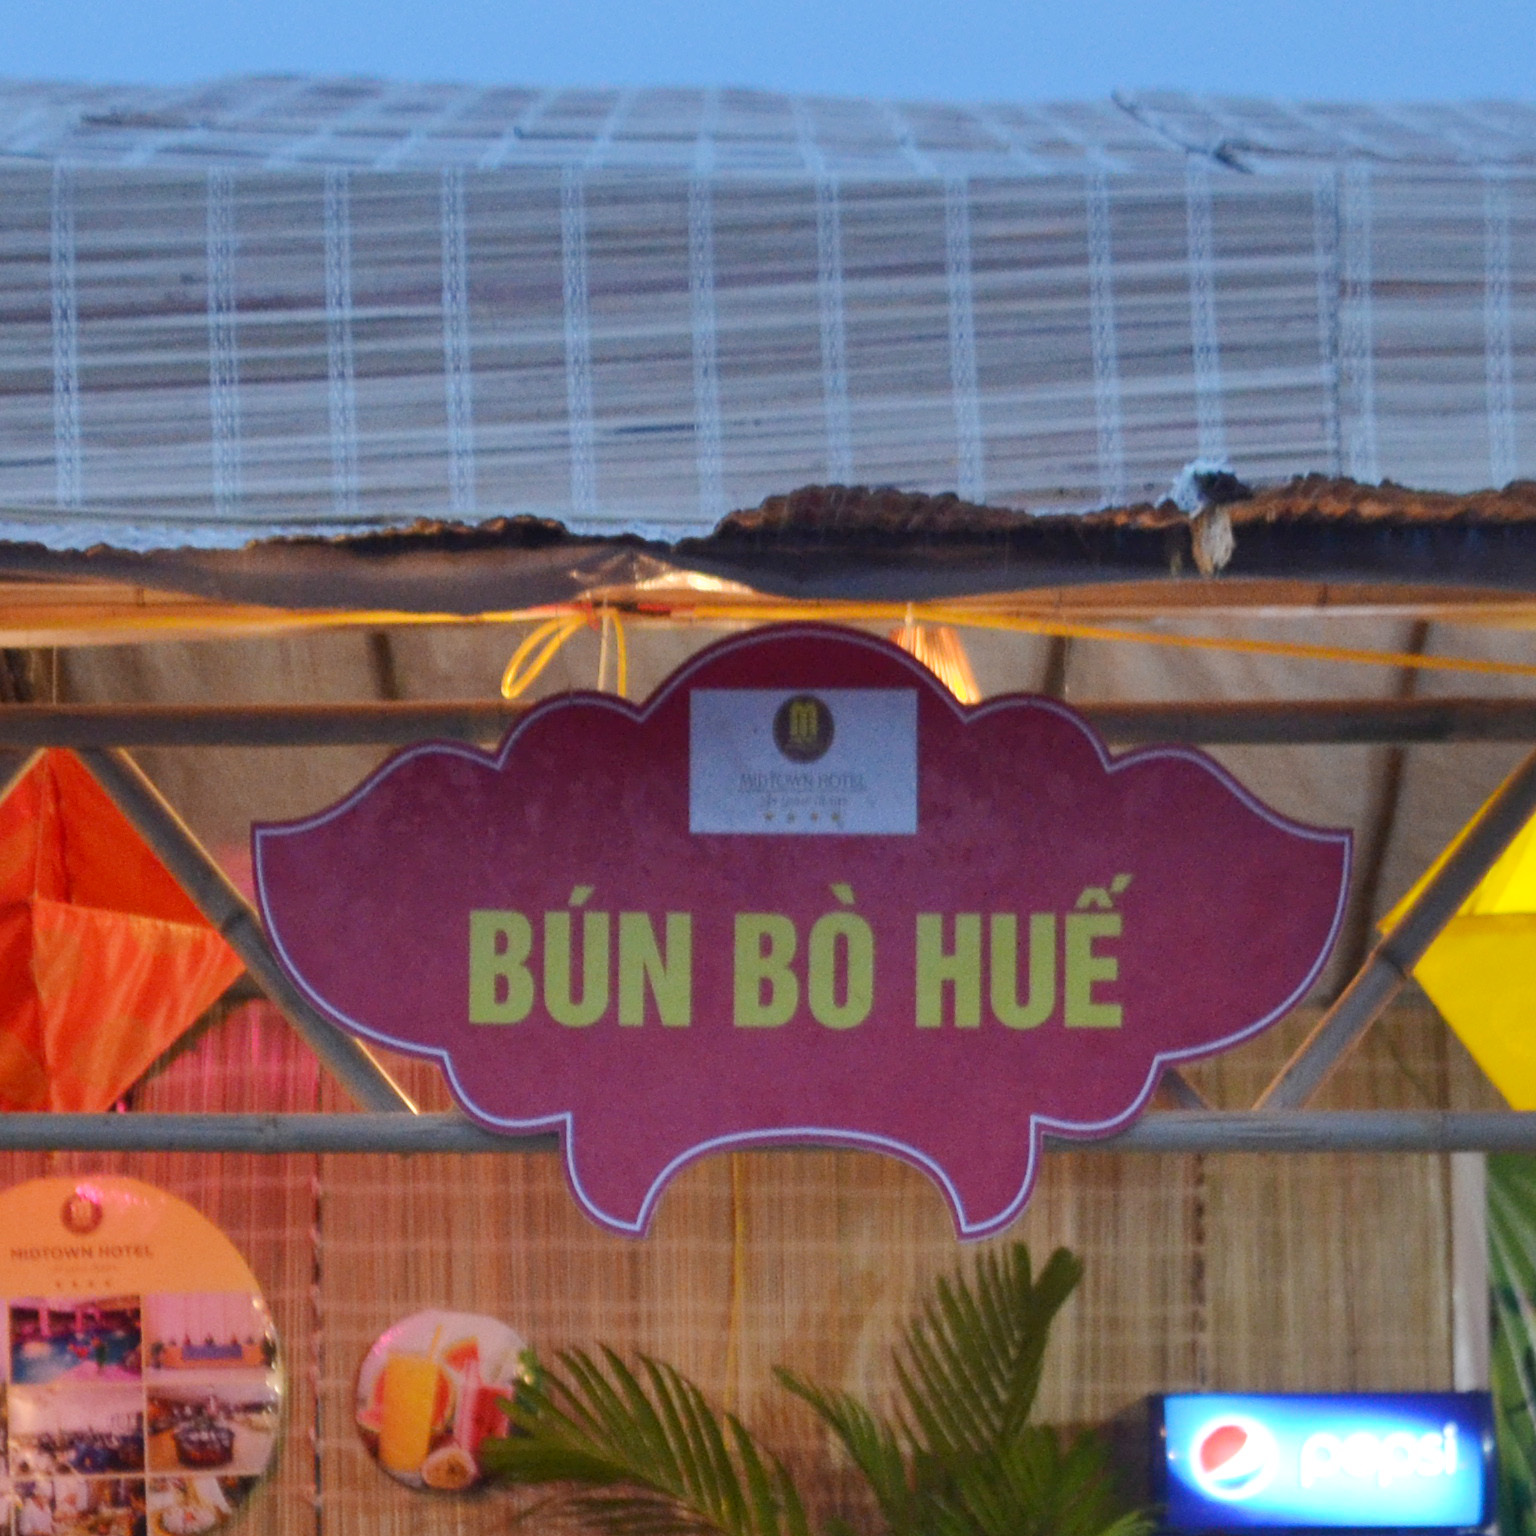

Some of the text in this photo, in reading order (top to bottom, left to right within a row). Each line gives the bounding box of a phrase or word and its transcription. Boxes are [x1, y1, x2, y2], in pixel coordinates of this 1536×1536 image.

[468, 873, 1133, 1030] BÚN BÒ HUẾ
[10, 1245, 155, 1260] MIDTOWN HOTEL
[1299, 1421, 1458, 1489] pepsi
